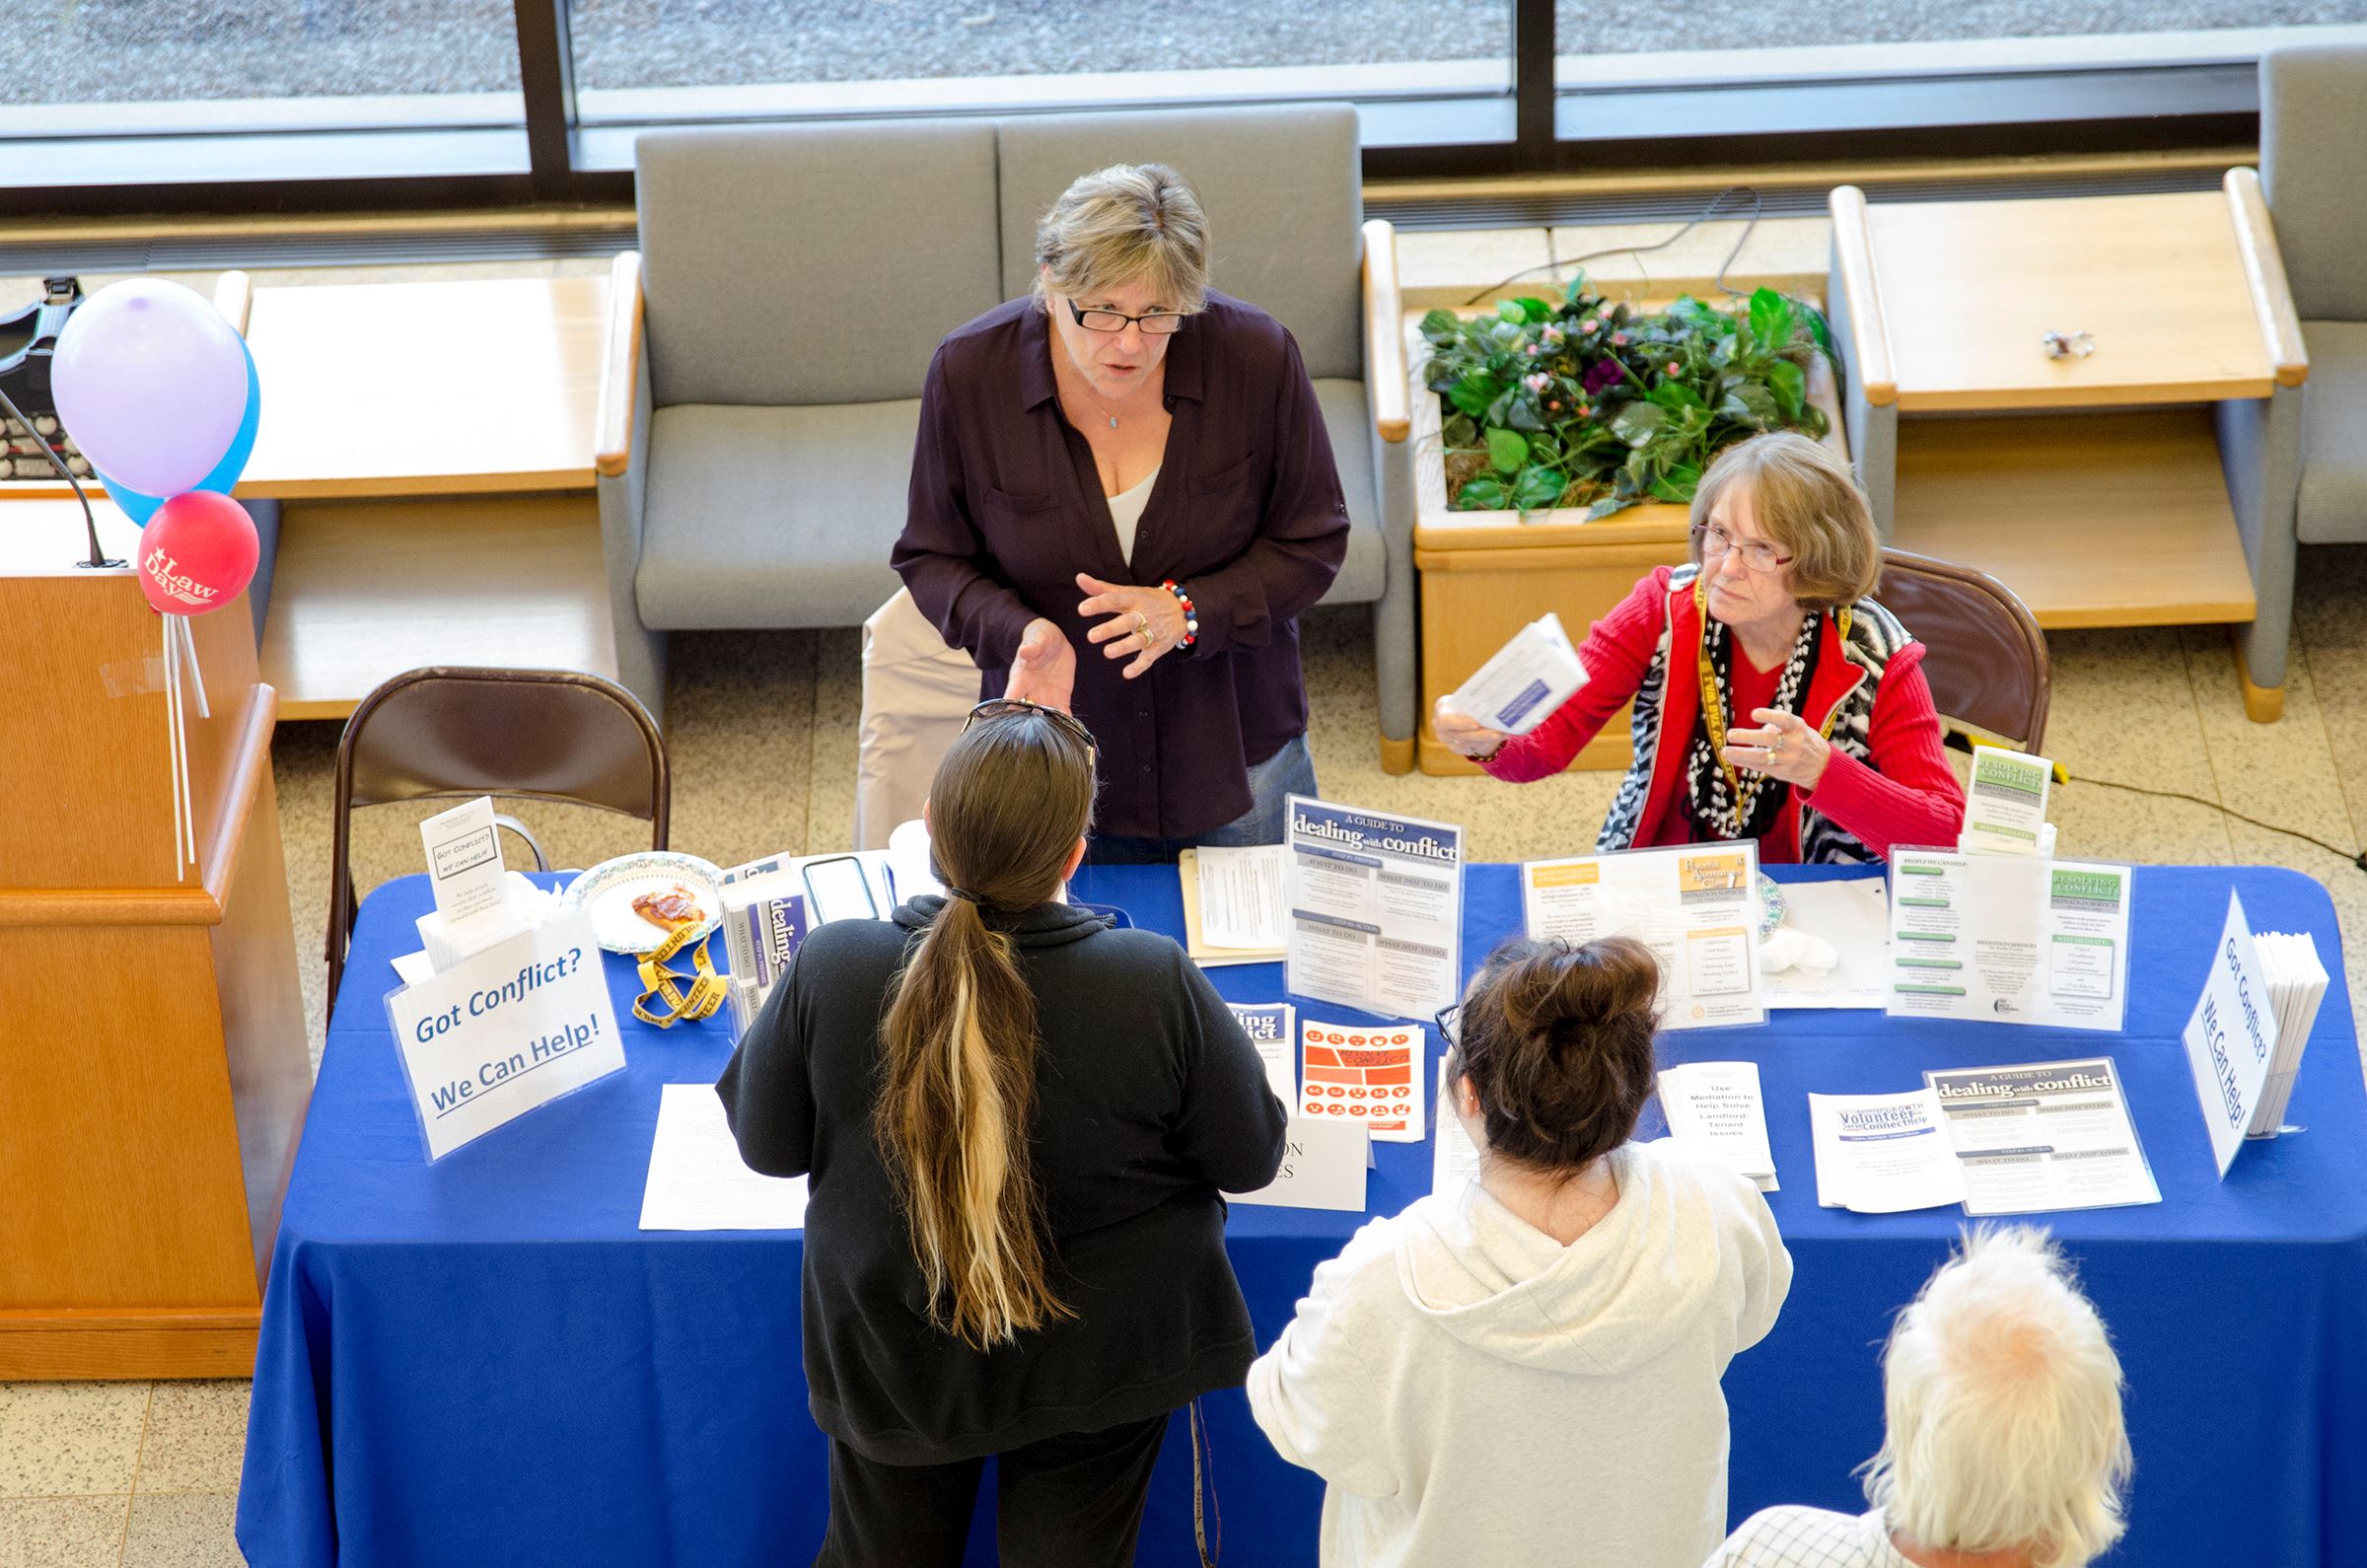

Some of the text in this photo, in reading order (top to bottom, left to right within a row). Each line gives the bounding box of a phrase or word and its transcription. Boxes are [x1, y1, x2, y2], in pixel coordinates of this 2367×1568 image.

[145, 552, 183, 596] Day
[161, 557, 219, 598] Law
[1978, 757, 2041, 779] RESOLVING
[1981, 769, 2044, 789] CONFLICTS
[1345, 816, 1404, 833] A GUIDE TO
[437, 833, 490, 860] GOT CONFLICT?
[1294, 814, 1364, 850] dealing
[1363, 837, 1382, 849] with
[1383, 836, 1458, 862] conflict
[443, 862, 453, 873] WE
[455, 856, 469, 868] CAN
[1310, 858, 1357, 875] WHAT TO DO
[1380, 873, 1402, 884] WHAT
[1403, 877, 1421, 887] NOT
[1422, 880, 1434, 889] TO
[2052, 875, 2116, 887] RESOLVING
[2057, 884, 2119, 894] CONFLICTS
[656, 922, 699, 960] VOLUNTEE
[769, 898, 795, 964] dealing
[1308, 924, 1356, 941] WHAT TO DO
[739, 922, 752, 967] WHAT TO DO
[1378, 938, 1399, 949] WHAT
[1400, 942, 1419, 952] NOT
[1420, 946, 1431, 955] TO
[415, 948, 581, 1043] Got Conflict?
[698, 992, 720, 1019] TEER
[749, 987, 757, 1010] WHAT
[2226, 937, 2267, 1063] Got Conflict?
[1234, 1011, 1277, 1031] ing
[430, 1079, 473, 1112] We
[478, 1052, 525, 1087] Can
[530, 1013, 601, 1062] Help!
[2203, 992, 2247, 1130] We Can Help!
[1938, 1082, 2014, 1098] dealing
[2013, 1084, 2033, 1093] with
[2033, 1073, 2115, 1092] conflict
[2000, 1071, 2032, 1081] GUIDE
[1840, 1110, 1913, 1124] Volunteer
[1887, 1103, 1924, 1113] GROWTH
[1862, 1119, 1907, 1131] Connect
[1907, 1115, 1928, 1127] Help
